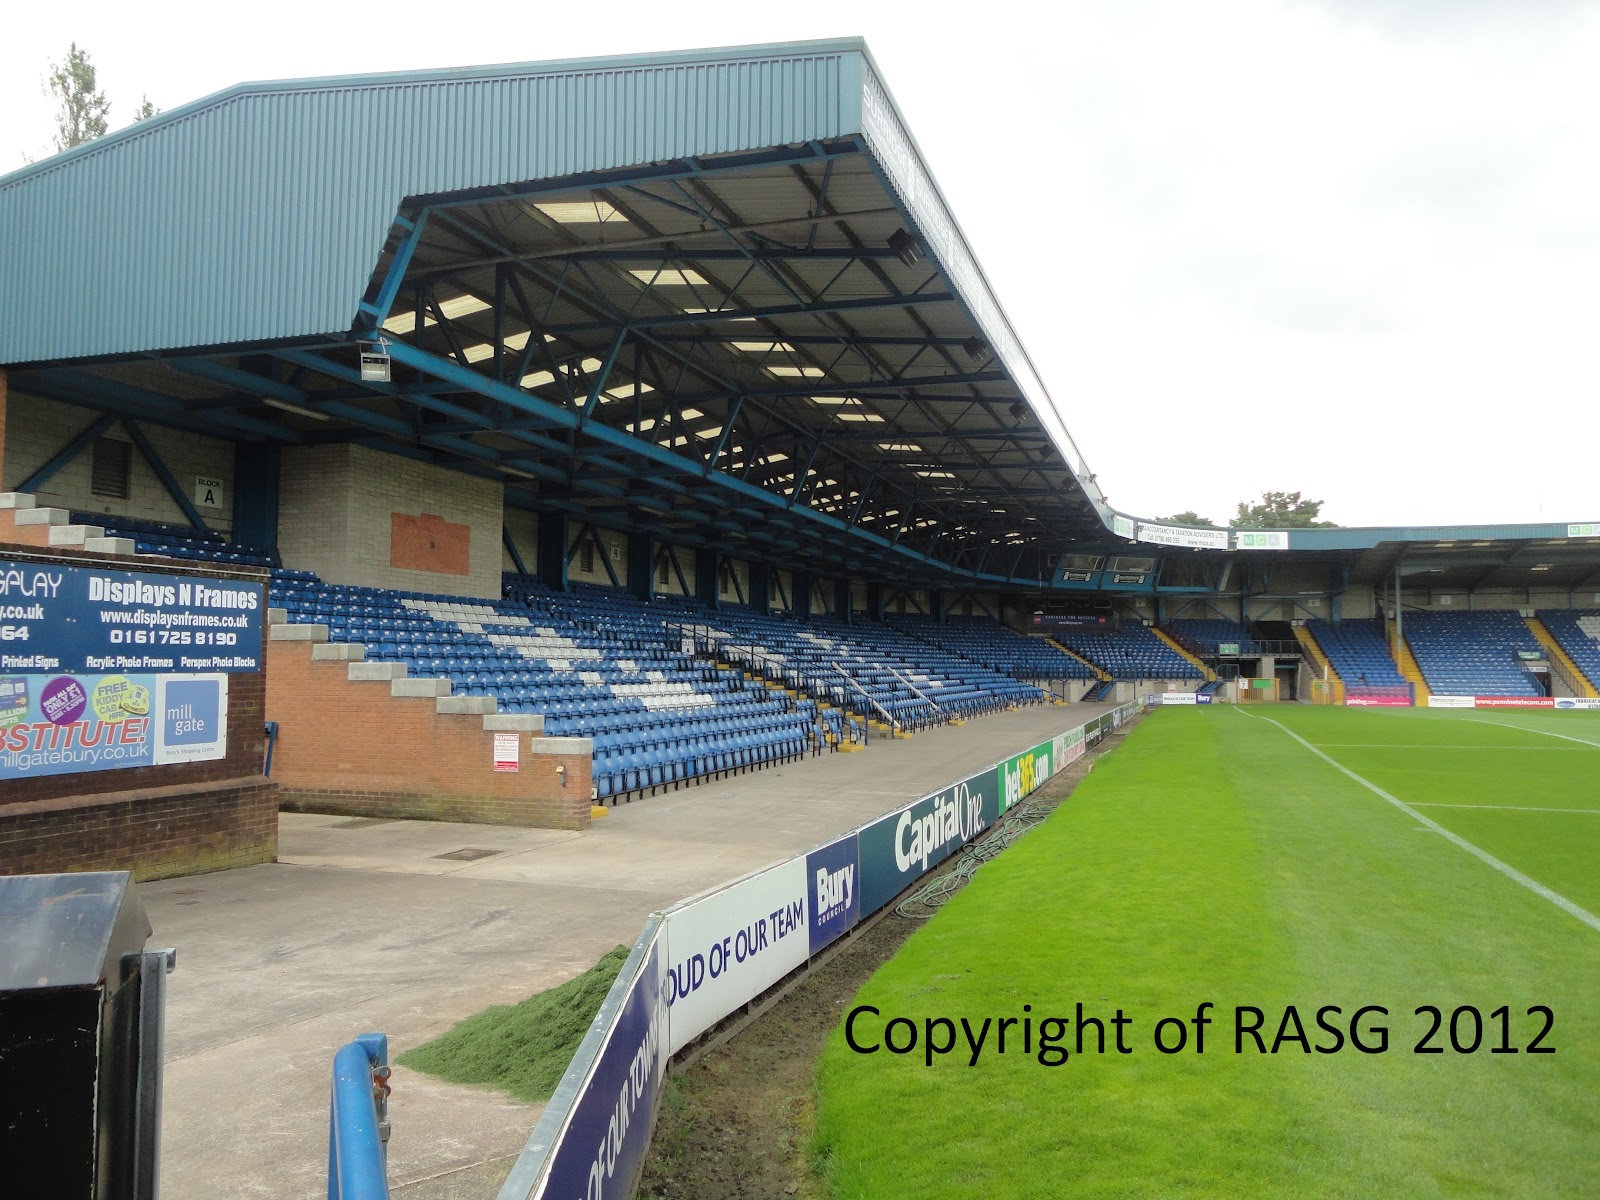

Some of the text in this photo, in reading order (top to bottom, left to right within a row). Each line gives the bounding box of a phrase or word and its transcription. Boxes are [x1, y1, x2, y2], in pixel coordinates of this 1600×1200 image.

[204, 489, 215, 505] A
[1243, 534, 1280, 546] MCA
[88, 576, 258, 610] Displays N Frames
[100, 609, 249, 629] www.displaysnframes.co.uk
[0, 625, 30, 641] 64
[110, 629, 237, 646] 0161 725 8190
[1, 655, 60, 671] Printed Signs
[86, 656, 174, 670] Acrylic Photo Frames
[180, 656, 256, 669] Perspex Photo Blocks
[57, 689, 68, 698] ALL
[66, 682, 77, 693] DAY
[97, 681, 129, 697] FREE
[46, 694, 70, 714] ONLY
[69, 686, 82, 699] £1
[95, 693, 124, 707] KIDDY
[1475, 698, 1554, 706] www.penninetelecom.com
[100, 704, 118, 715] CAB
[108, 710, 126, 720] HIRE
[167, 703, 192, 720] mill
[174, 717, 205, 736] gate
[180, 747, 201, 755] Shopping
[1004, 753, 1049, 808] bet365.com
[816, 863, 855, 916] Bury
[817, 905, 845, 927] COUNCIL
[709, 936, 732, 979] OF
[735, 918, 769, 964] OUR
[769, 898, 804, 943] TEAM
[607, 1079, 630, 1179] OUR
